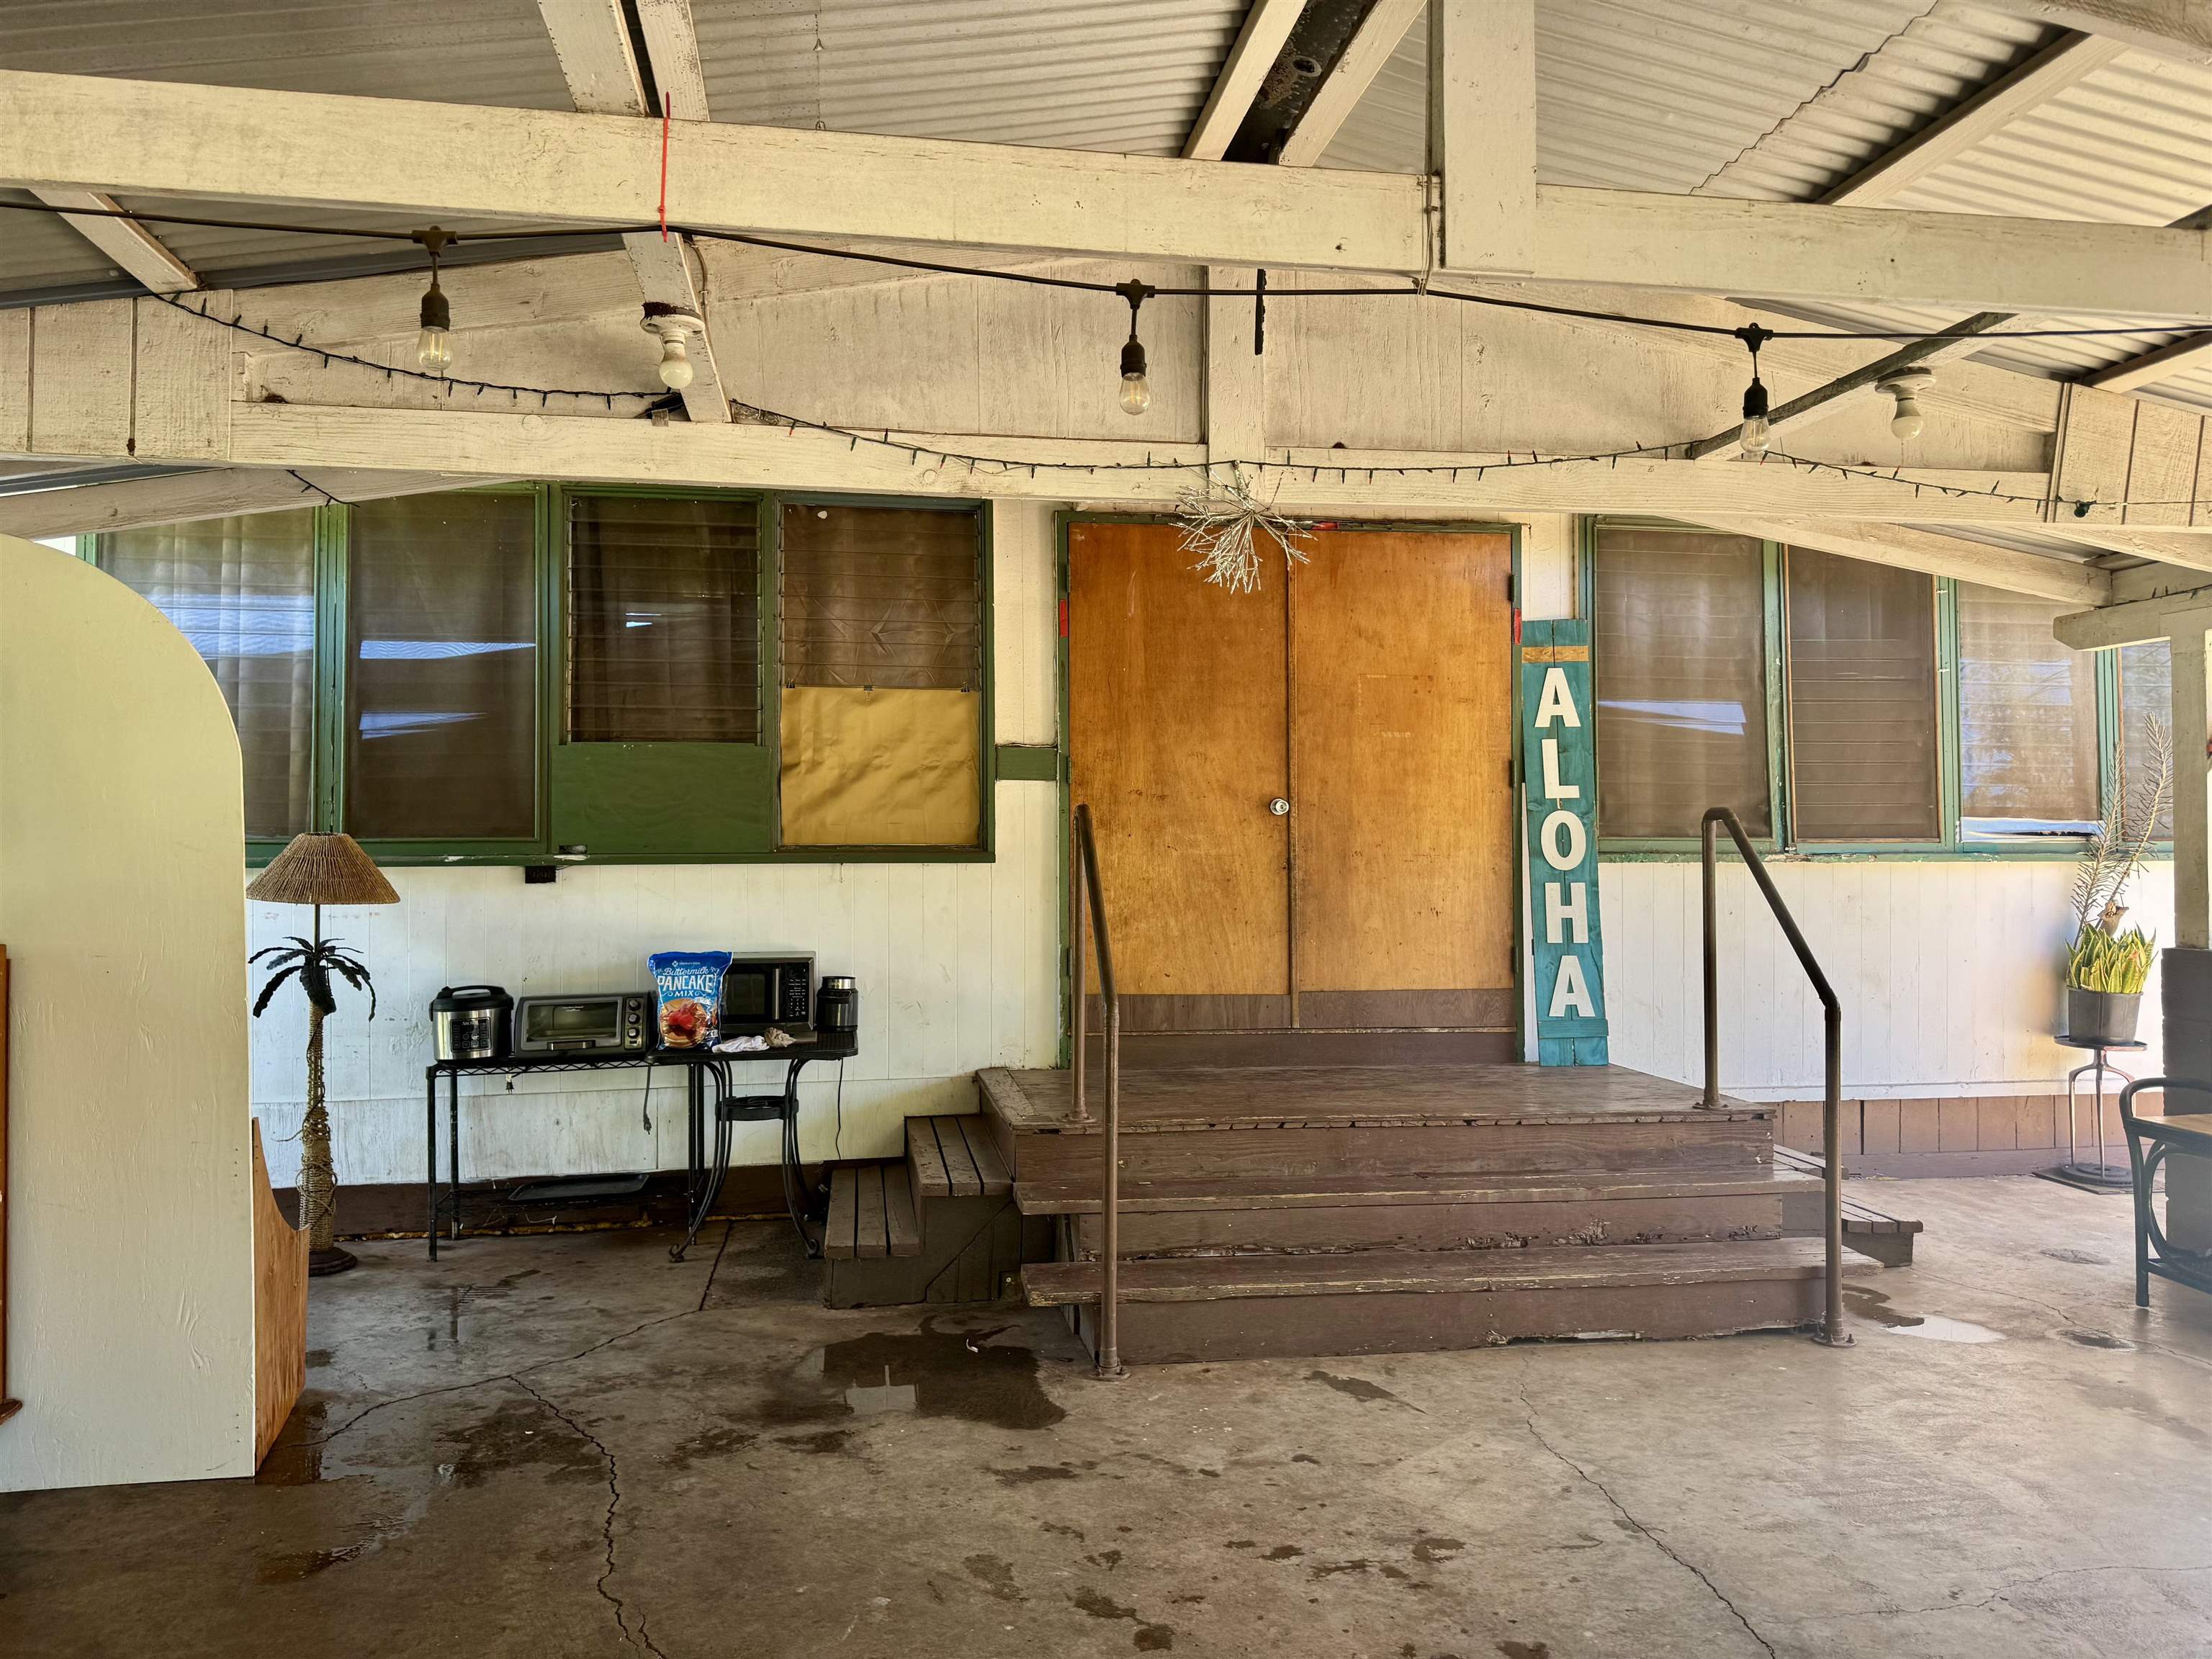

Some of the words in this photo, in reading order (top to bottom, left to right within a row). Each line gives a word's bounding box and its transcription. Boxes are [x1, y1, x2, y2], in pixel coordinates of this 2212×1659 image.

[1534, 667, 1595, 1017] ALOHA
[662, 966, 709, 976] Buttermilk
[657, 974, 713, 993] PANCAKE
